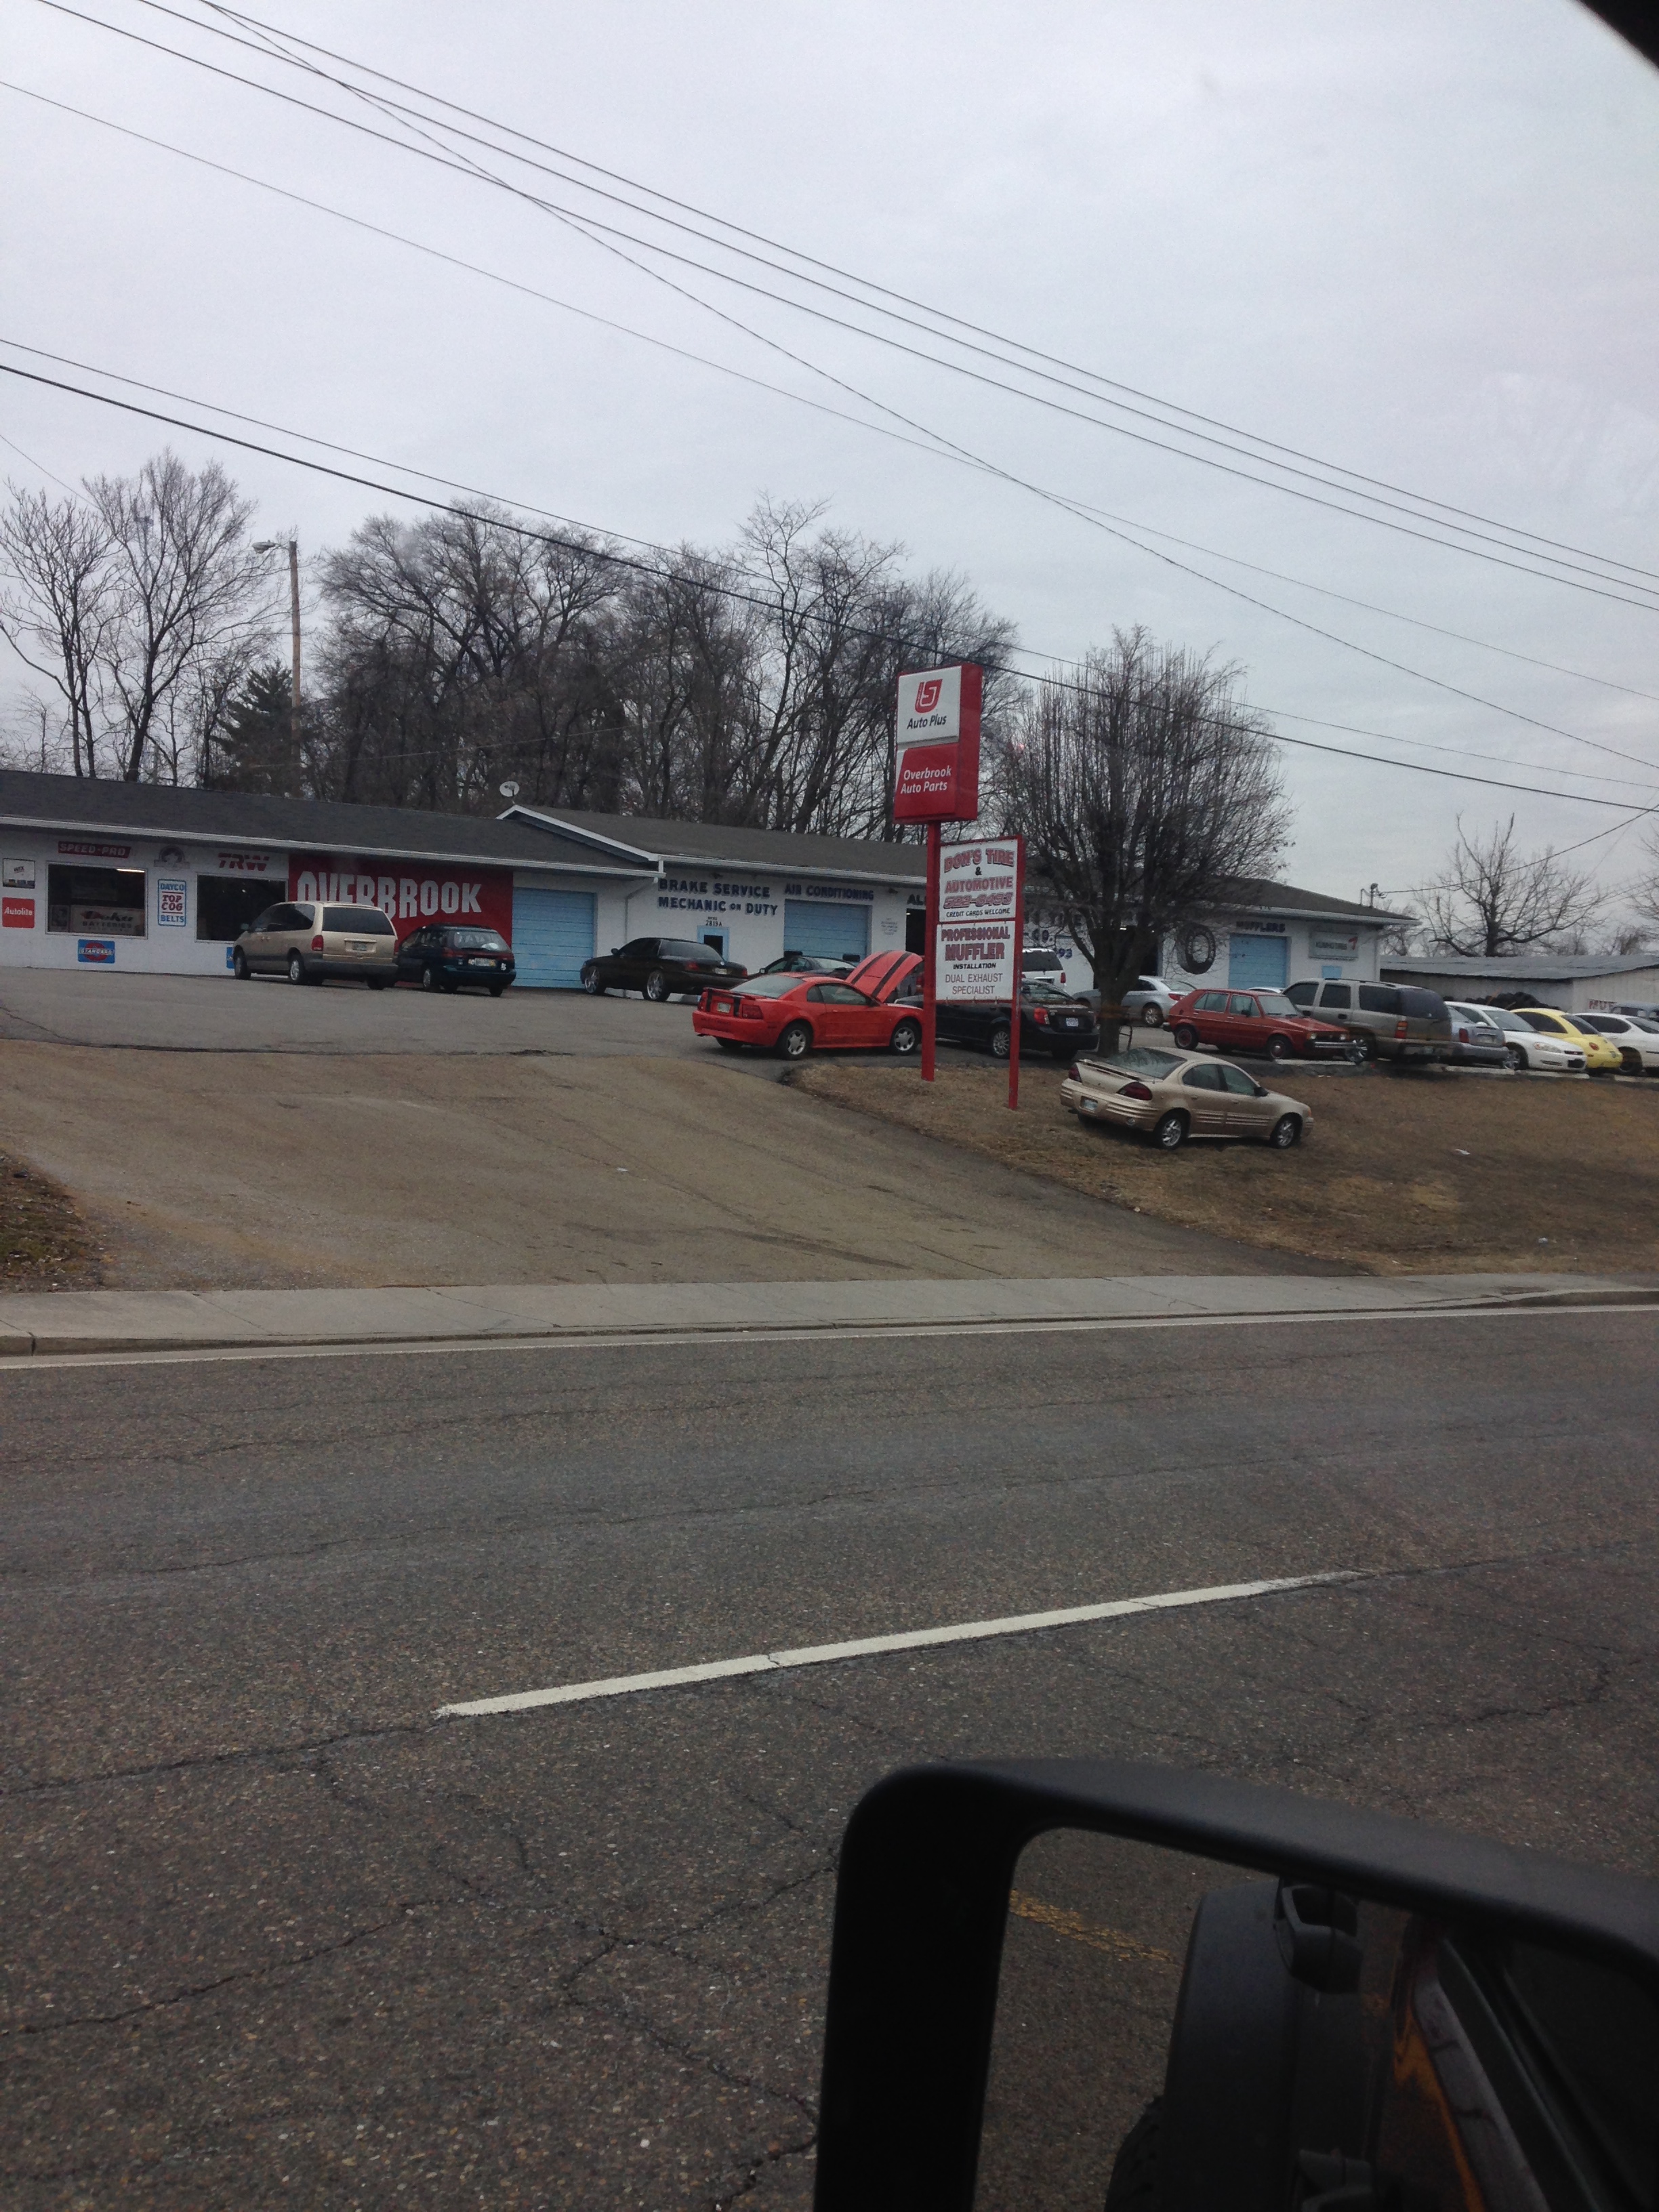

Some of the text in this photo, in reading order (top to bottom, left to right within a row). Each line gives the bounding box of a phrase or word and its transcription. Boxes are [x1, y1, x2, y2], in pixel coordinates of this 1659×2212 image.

[907, 714, 947, 730] Auto Plus
[903, 765, 951, 781] Overbrook
[901, 781, 947, 794] Auto Parts
[59, 843, 127, 857] SPEED-PRO
[218, 853, 270, 872] TRW
[944, 847, 1015, 873] DON'S TIRE
[975, 866, 982, 876] &
[160, 883, 184, 891] DAYCO
[658, 878, 771, 899] BRAKE SERVICE
[784, 883, 874, 901] AIR CONDITIONING
[945, 875, 1013, 894] AUTOMOTIVE
[163, 895, 182, 903] TOP
[297, 871, 482, 920] OVERBROOK
[943, 892, 1013, 909] 522-6493
[4, 907, 33, 916] Autolite
[161, 902, 183, 911] COG
[657, 897, 726, 913] MECHANIC
[744, 902, 778, 916] DUTY
[946, 910, 964, 918] CREDIT
[984, 907, 1010, 916] WELCOME
[161, 914, 184, 923] BELTS
[941, 926, 1010, 942] PROFESSIONAL
[945, 943, 1005, 962] MUFFLER
[945, 973, 1003, 983] DUAL EXHAUST
[952, 985, 996, 995] SPECIALIST
